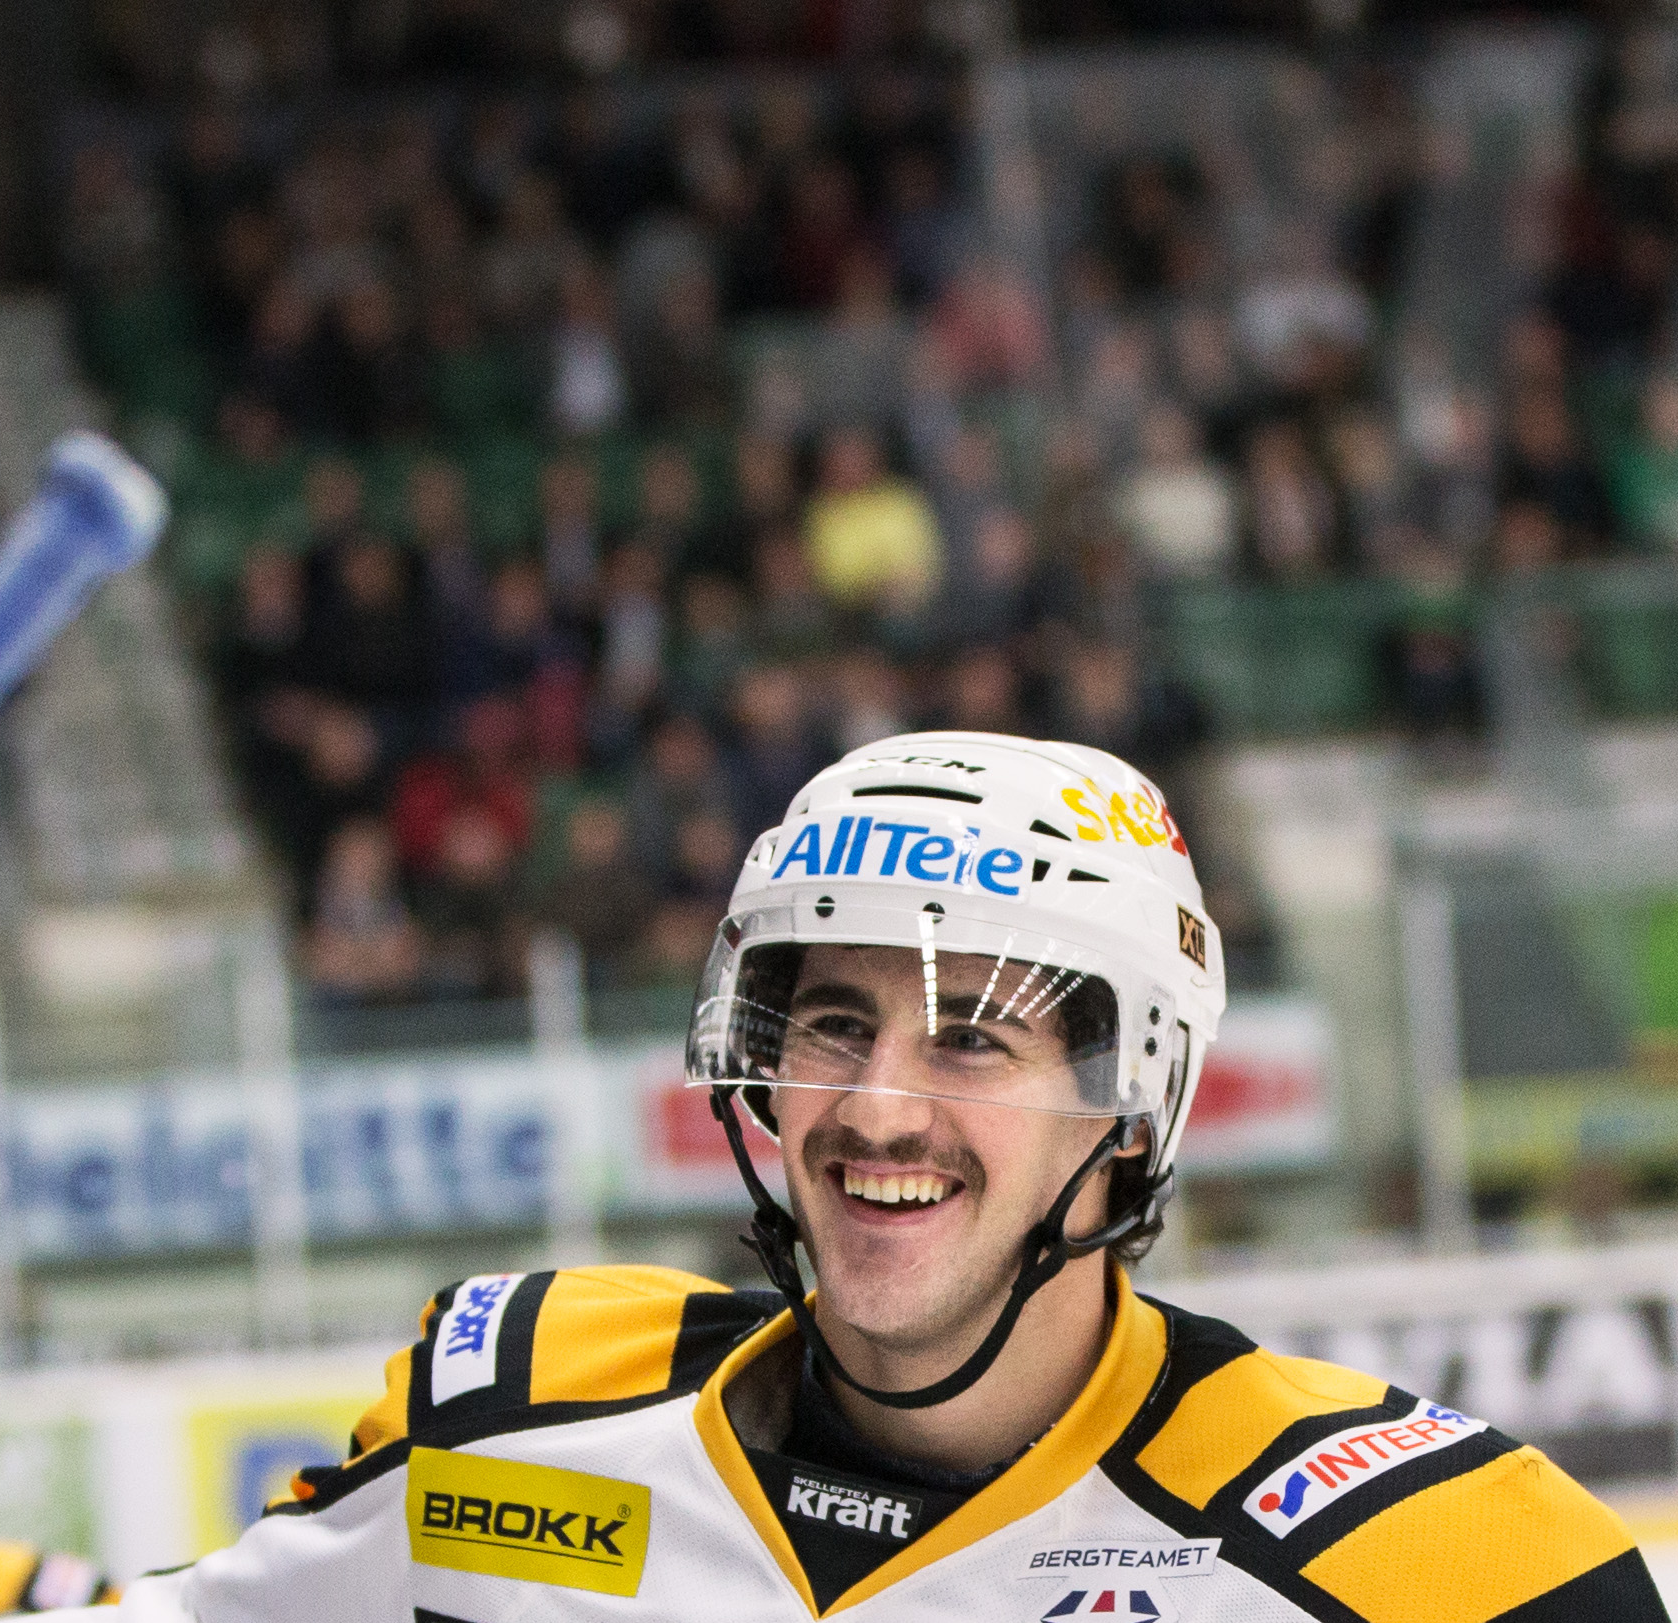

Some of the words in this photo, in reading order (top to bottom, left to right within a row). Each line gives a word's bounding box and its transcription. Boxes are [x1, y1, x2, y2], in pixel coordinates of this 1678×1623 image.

[445, 1273, 511, 1357] SPORT
[787, 1484, 912, 1539] kraft
[1028, 1546, 1210, 1570] BERGTEAMET
